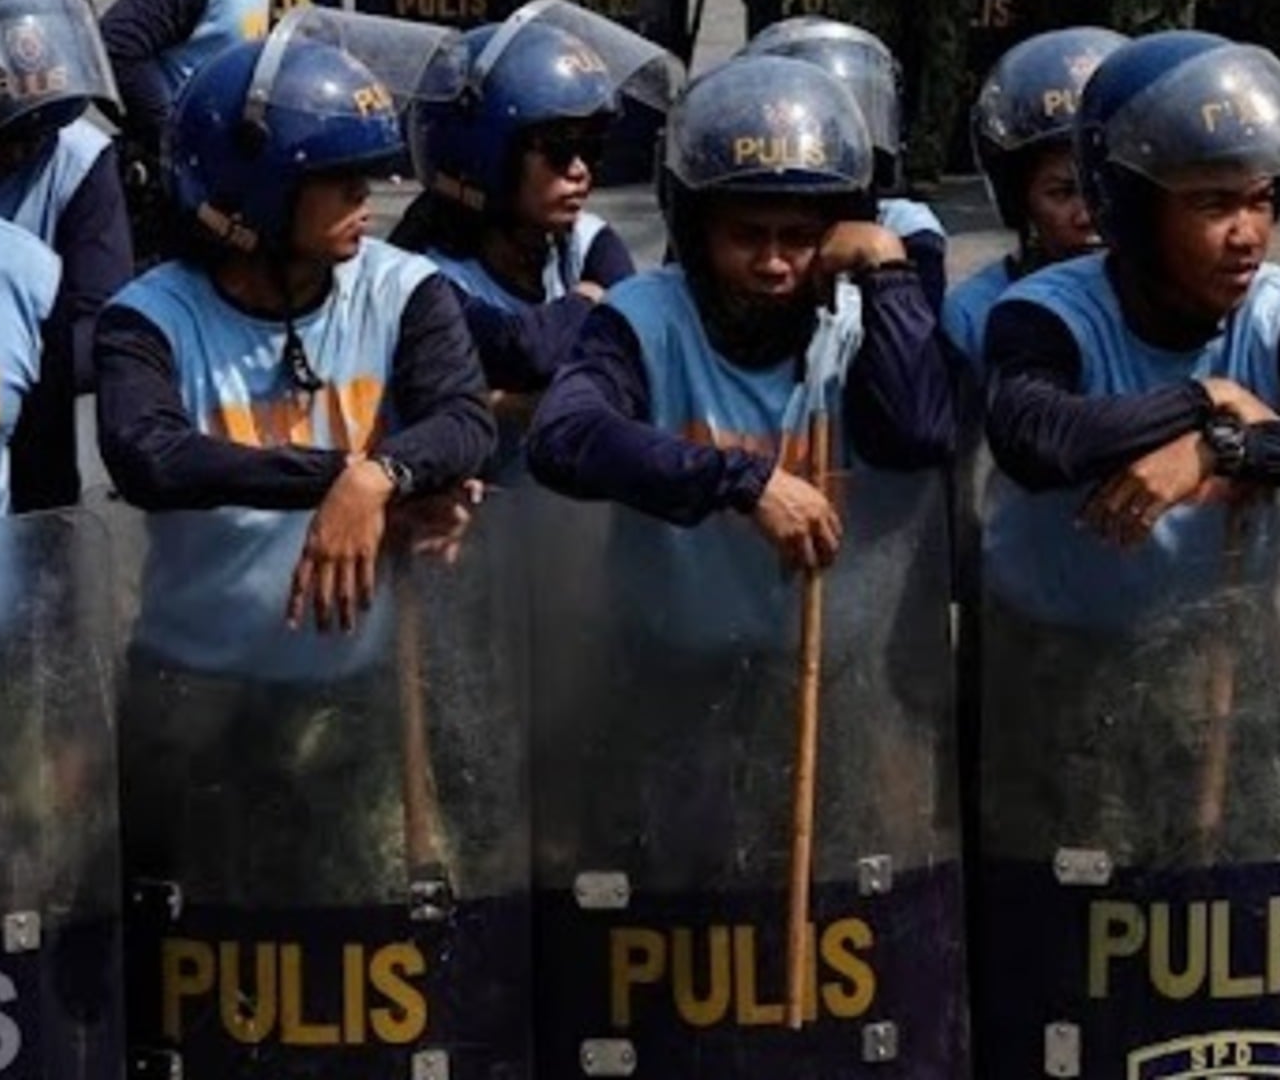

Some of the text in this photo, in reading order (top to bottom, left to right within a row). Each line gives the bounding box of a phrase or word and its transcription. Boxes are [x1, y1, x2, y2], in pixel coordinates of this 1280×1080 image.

[734, 137, 827, 166] PULIS
[160, 940, 428, 1044] PULIS
[1190, 1043, 1252, 1071] SPD
